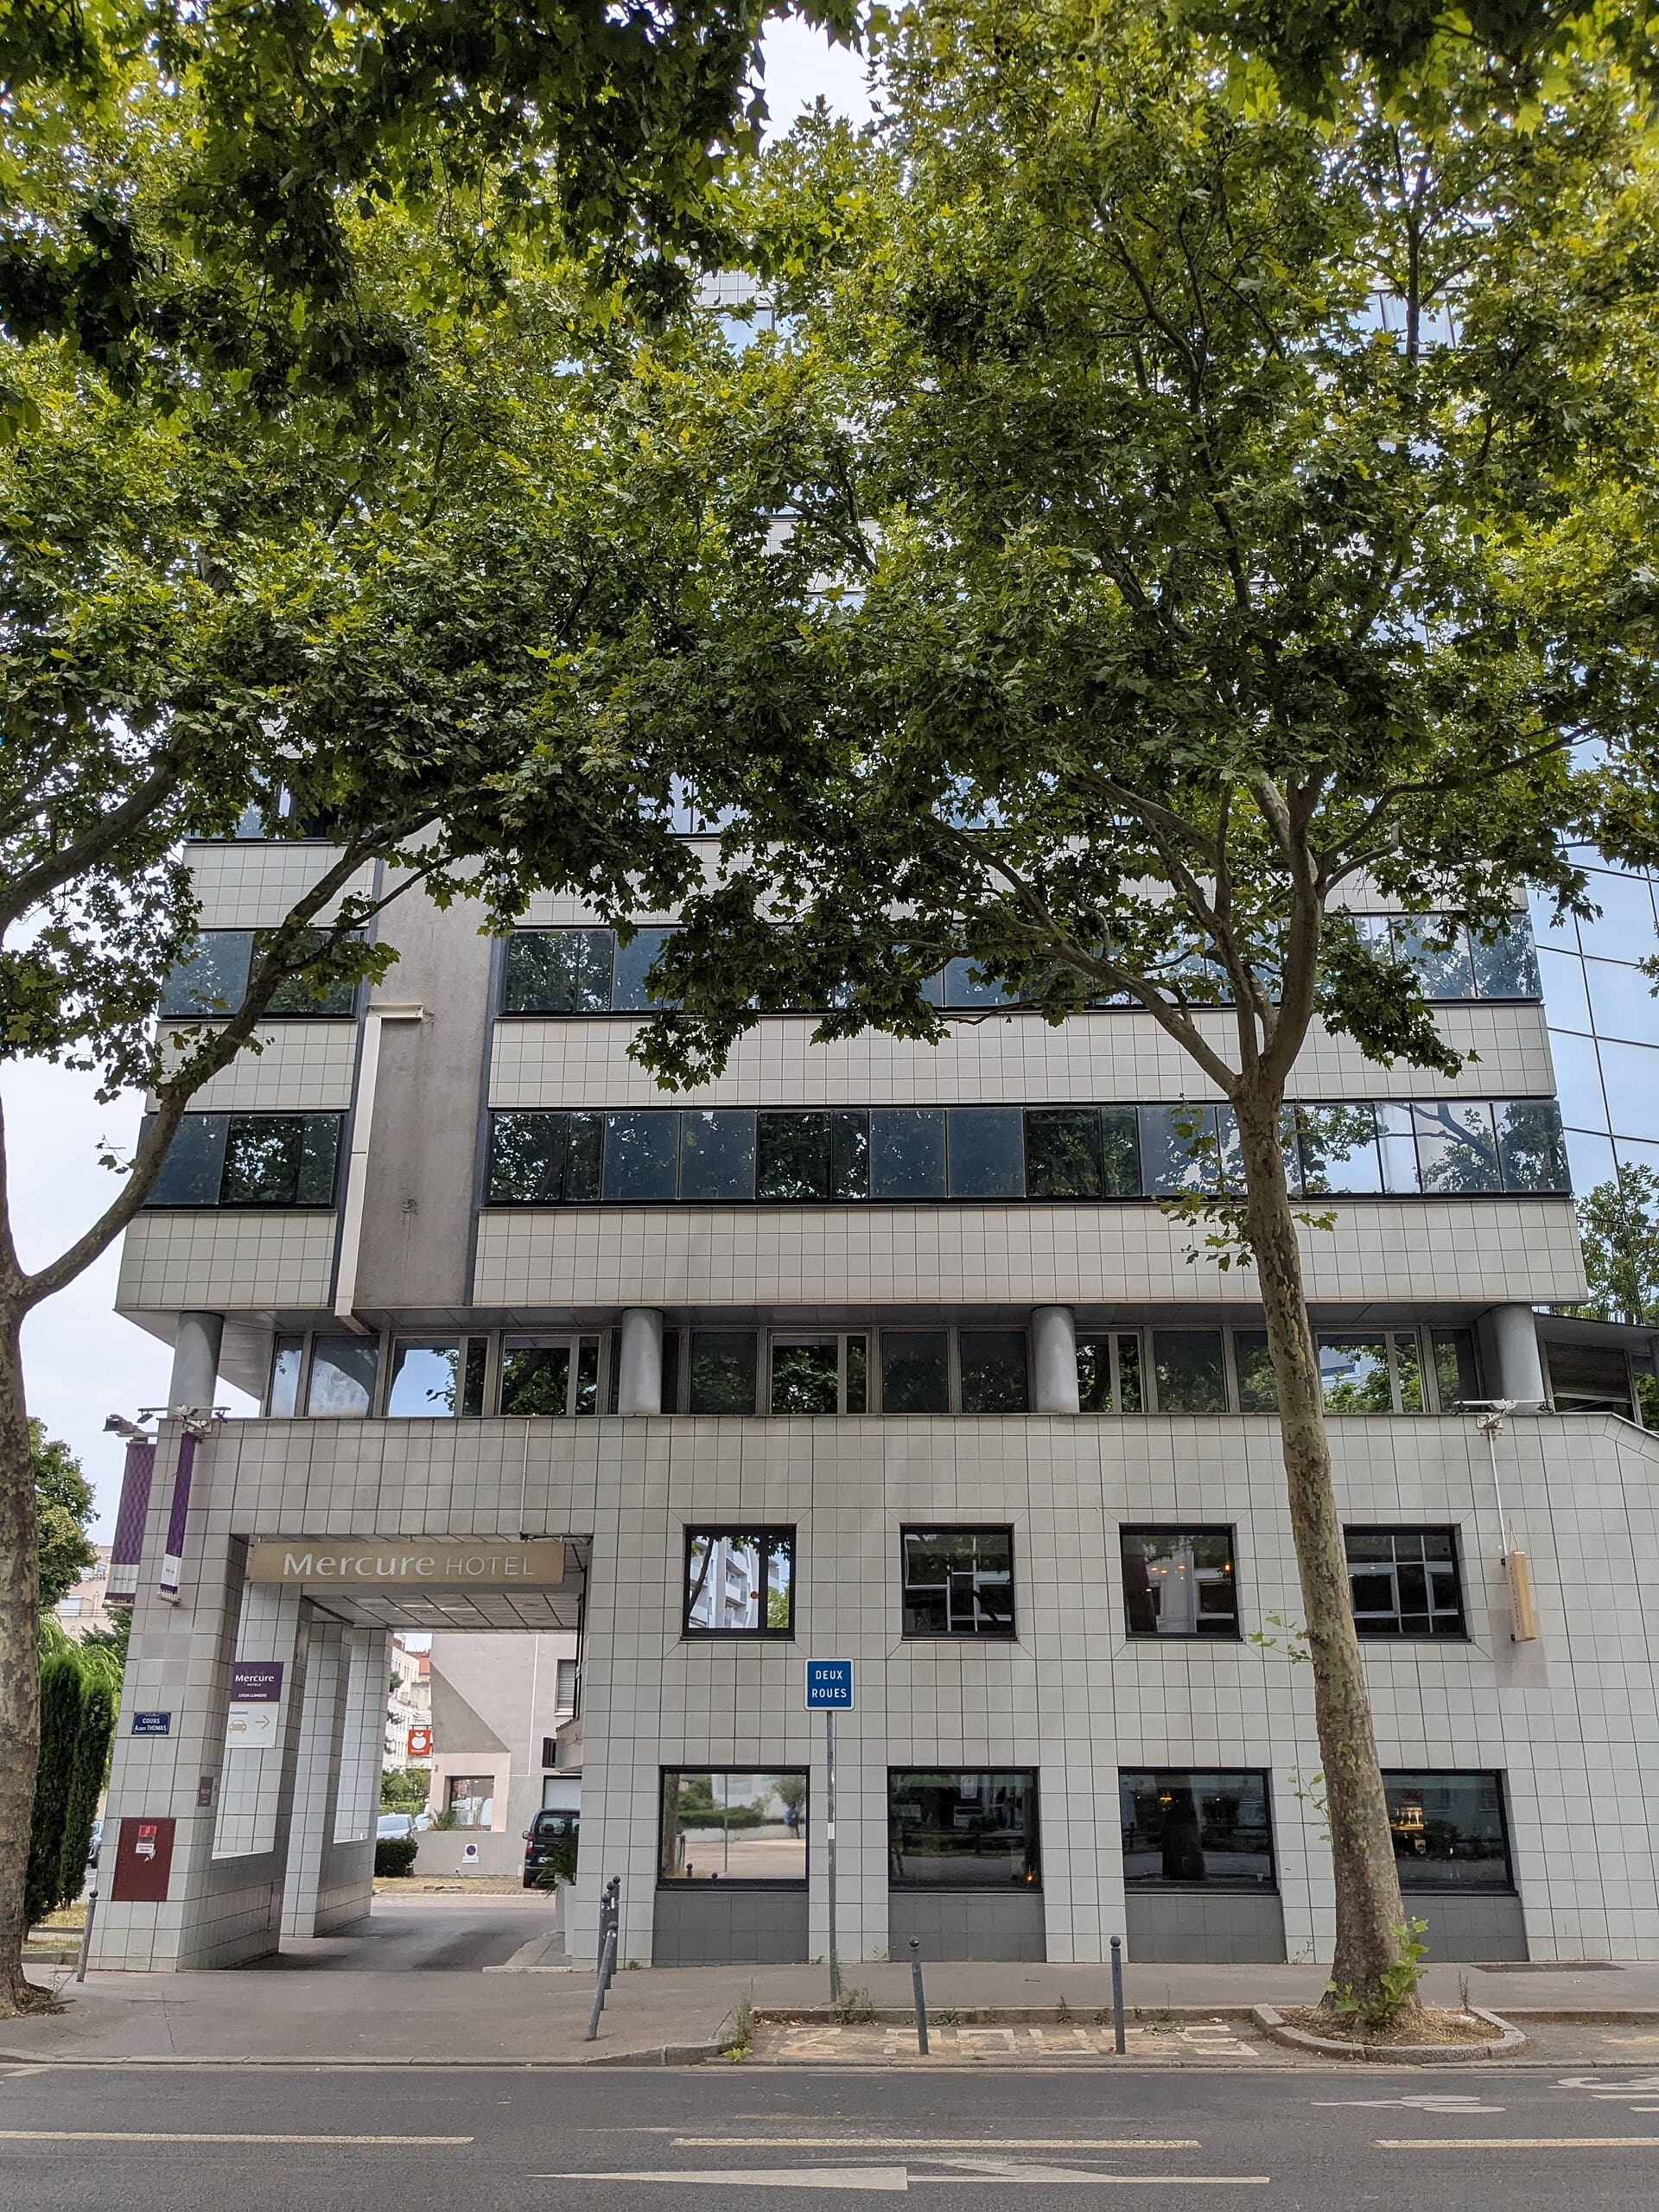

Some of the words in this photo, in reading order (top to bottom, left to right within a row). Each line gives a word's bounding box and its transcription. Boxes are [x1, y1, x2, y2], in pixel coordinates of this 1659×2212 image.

[283, 1552, 436, 1577] Mercure
[445, 1555, 537, 1577] HOTEL
[235, 1674, 276, 1683] Mercure
[815, 1669, 843, 1681] DEUX
[811, 1688, 848, 1699] ROUES
